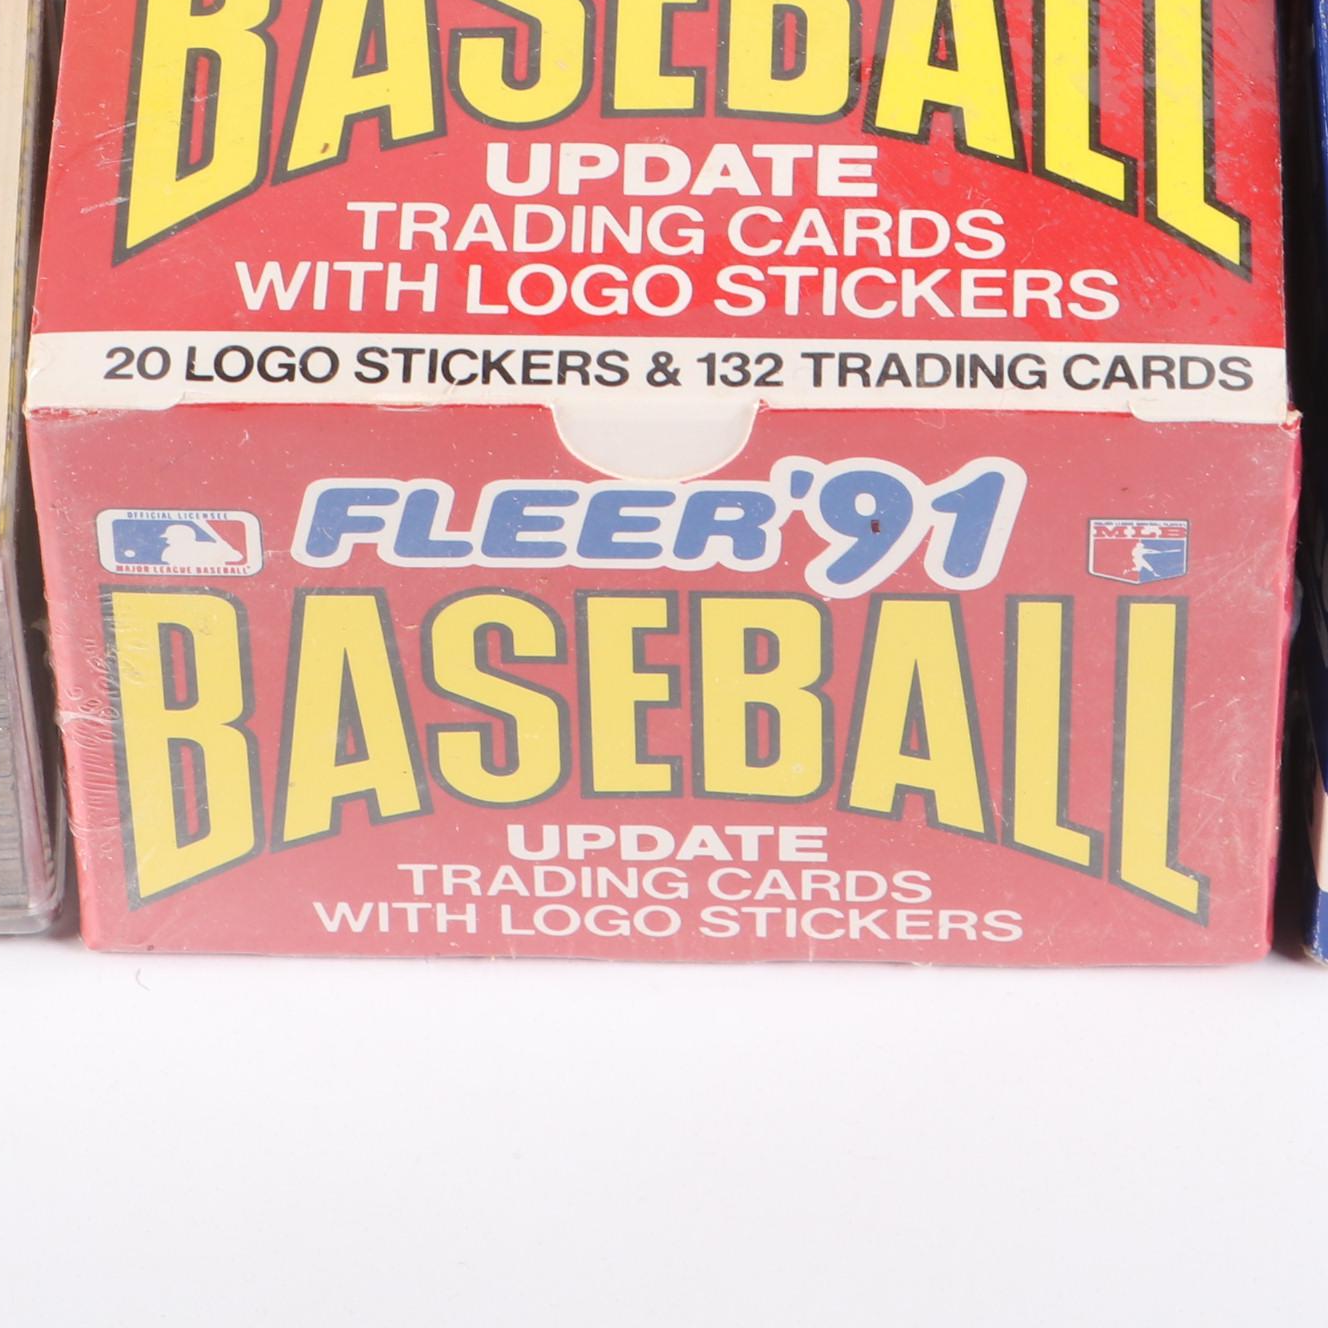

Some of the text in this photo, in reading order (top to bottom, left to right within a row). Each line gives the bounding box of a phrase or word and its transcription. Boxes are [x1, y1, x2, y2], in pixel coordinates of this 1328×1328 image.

[486, 143, 880, 198] UPDATE
[347, 201, 1006, 259] TRADING CARDS
[235, 260, 1121, 321] WITH LOGO STICKERS
[103, 345, 1255, 394] 20 LOGO STICKERS & 132 TRADING CARDS
[127, 511, 172, 519] OFFICIAL
[1092, 526, 1187, 539] MLB
[116, 565, 248, 575] MAJOR LEAGUE BASEBALL
[98, 587, 1210, 926] BASEBALL
[507, 824, 832, 864] UPDATE
[398, 864, 934, 903] TRADING CARDS
[313, 900, 1024, 941] WITH LOGO STICKERS
